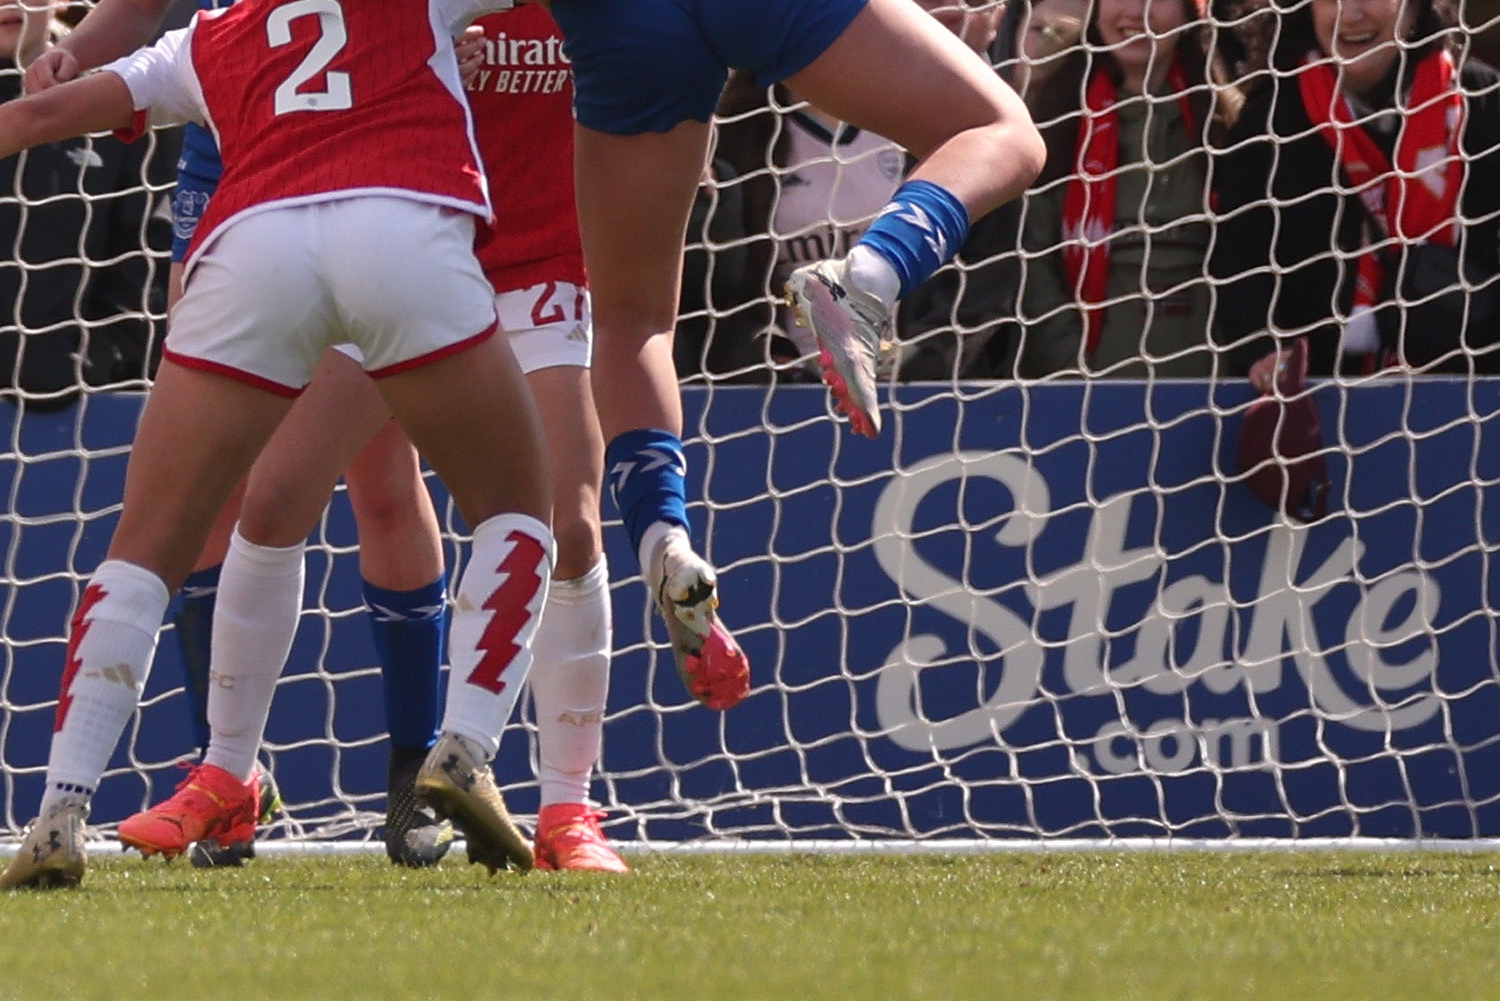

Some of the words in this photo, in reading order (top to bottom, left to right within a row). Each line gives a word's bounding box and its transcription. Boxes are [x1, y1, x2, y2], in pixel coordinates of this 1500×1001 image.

[495, 69, 569, 94] BETTER
[872, 450, 1441, 753] Stake
[1072, 716, 1281, 775] .com
